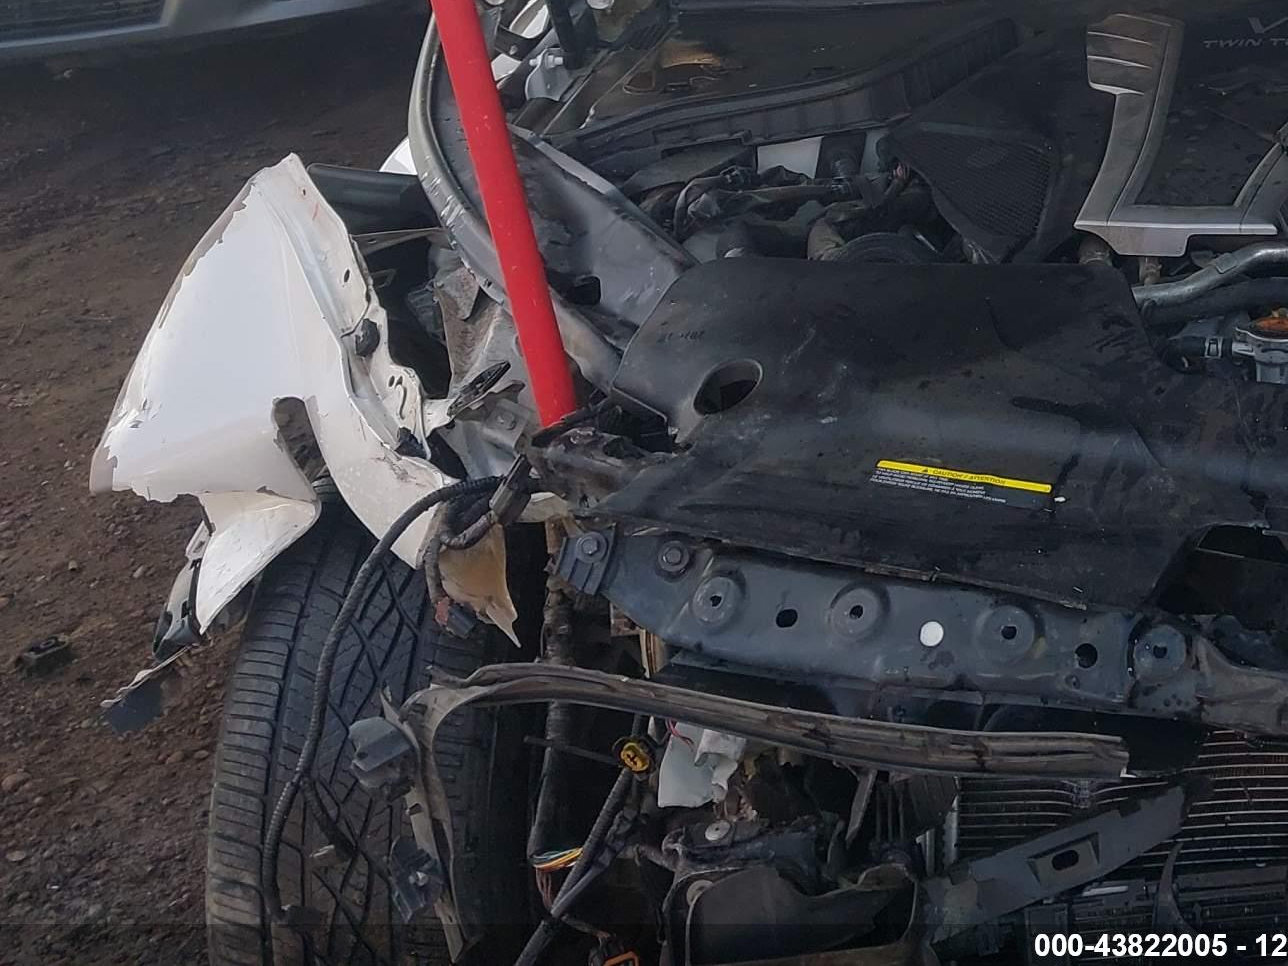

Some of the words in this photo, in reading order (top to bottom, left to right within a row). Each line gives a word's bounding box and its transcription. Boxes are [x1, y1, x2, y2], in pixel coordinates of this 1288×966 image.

[1203, 38, 1263, 48] TWIN
[933, 469, 962, 480] CAUTION
[969, 474, 1007, 485] ATTENTION
